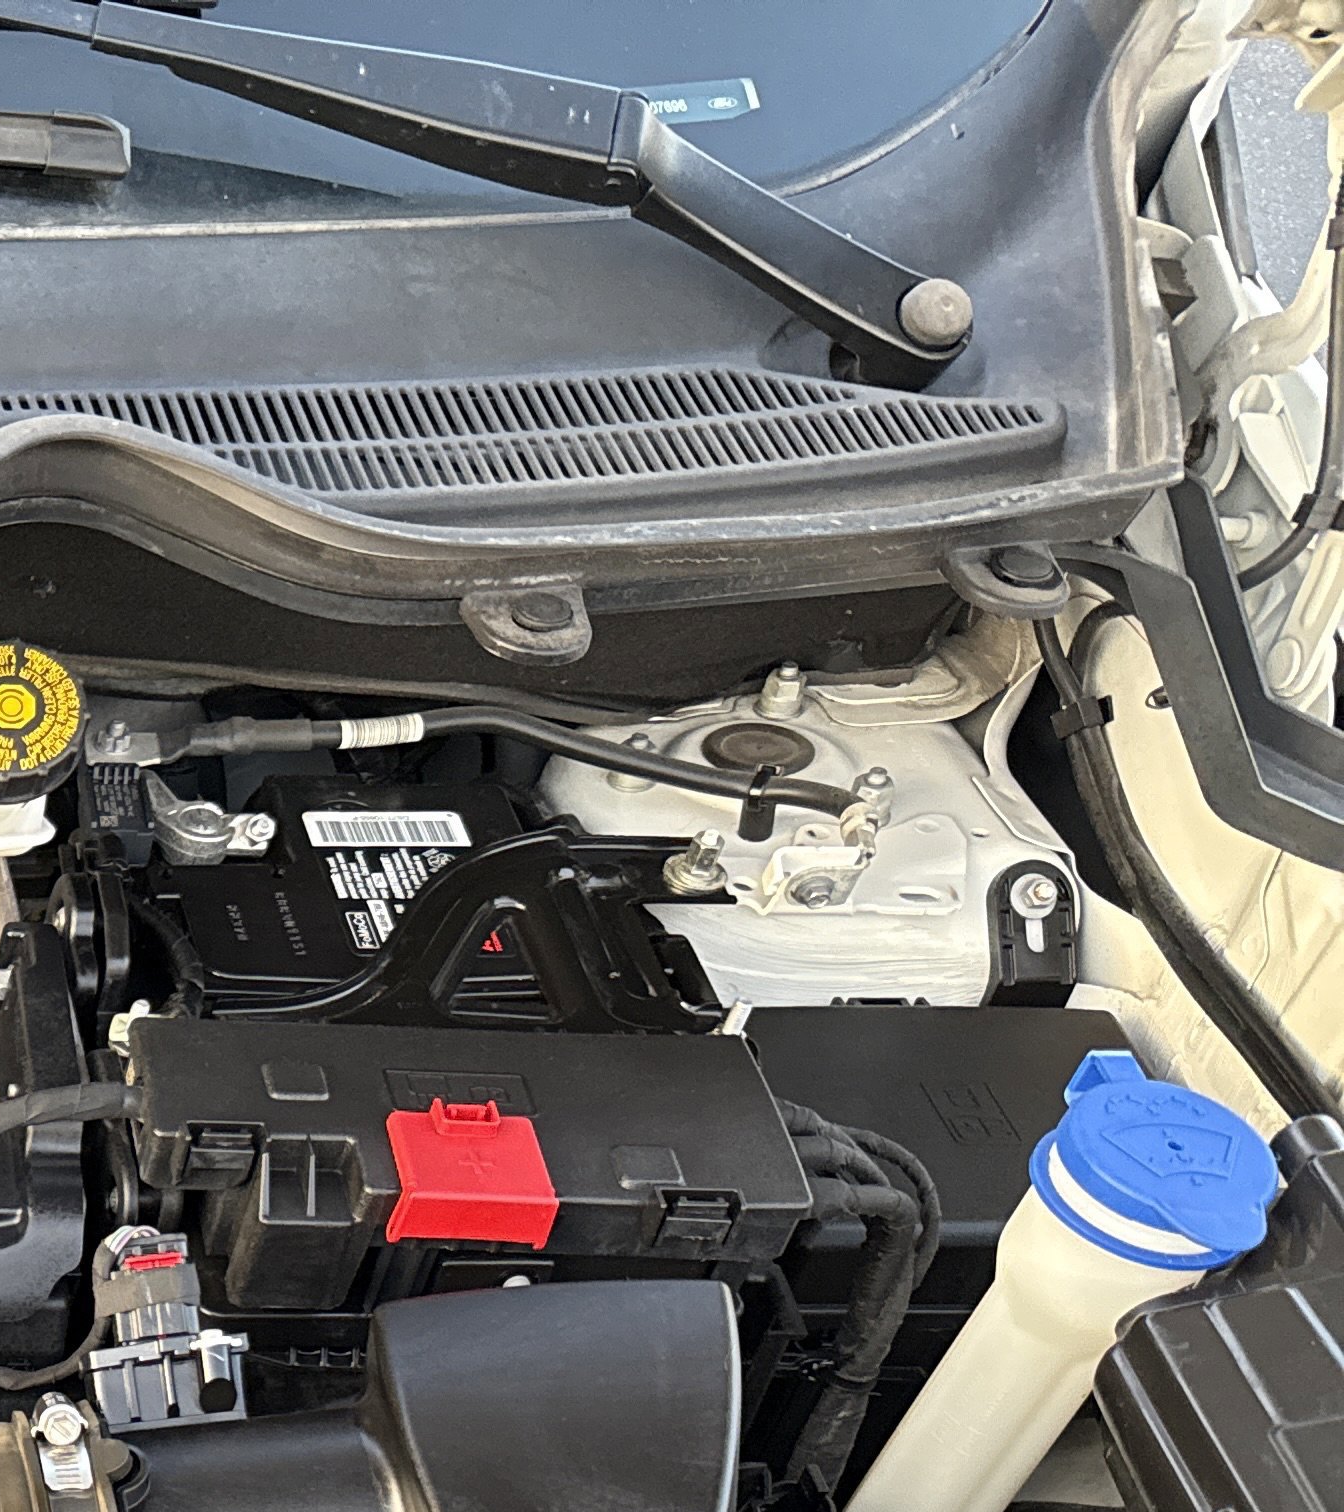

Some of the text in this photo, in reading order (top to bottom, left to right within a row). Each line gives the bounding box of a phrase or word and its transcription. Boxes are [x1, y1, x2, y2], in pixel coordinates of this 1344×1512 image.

[23, 646, 69, 680] CONTAINER
[18, 666, 56, 747] WARNING CLEAN FILLER
[24, 657, 68, 758] CAP BEFORE REMOVING USE ONLY
[61, 676, 80, 708] SEALED
[59, 716, 79, 741] FROM
[19, 755, 40, 770] DOT
[36, 752, 47, 764] 4
[43, 737, 68, 760] FLUID
[353, 912, 373, 948] FoMoCo
